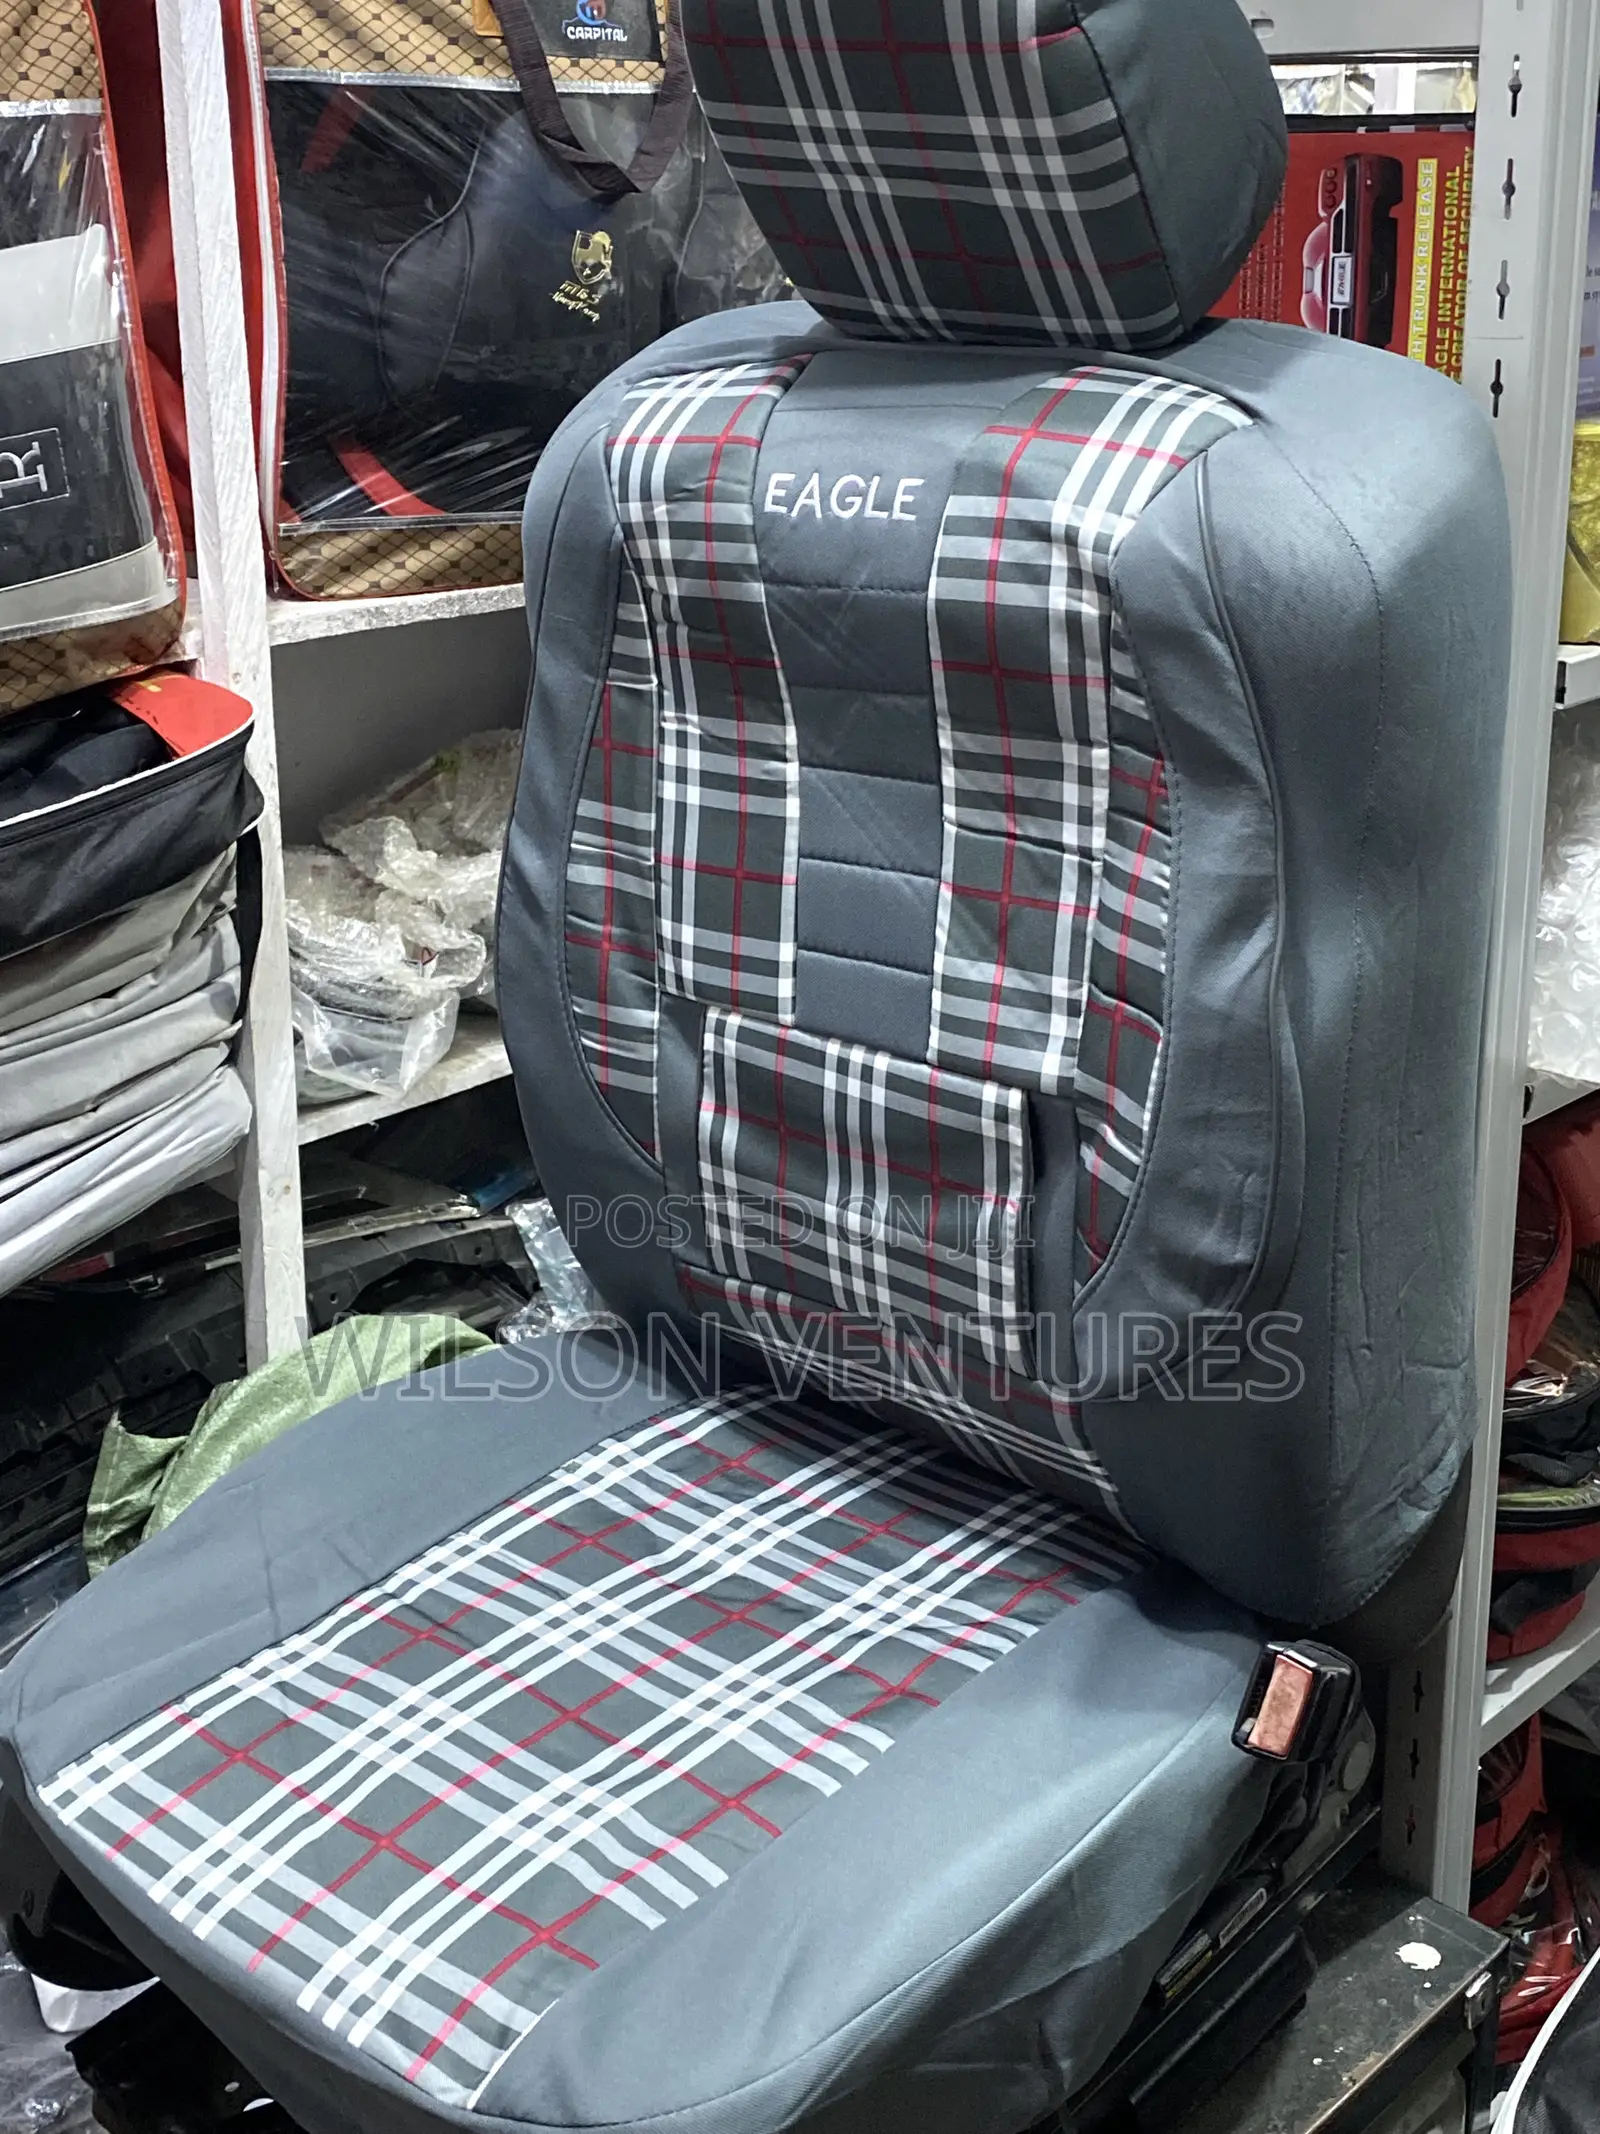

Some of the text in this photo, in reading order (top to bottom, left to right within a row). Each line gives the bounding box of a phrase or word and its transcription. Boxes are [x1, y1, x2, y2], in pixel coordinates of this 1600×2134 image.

[566, 26, 628, 42] CARPITAL
[1416, 162, 1434, 258] RELEASE
[1411, 263, 1428, 333] TRUNK
[1435, 165, 1461, 375] AGLE INTERNATIONAL
[763, 472, 925, 522] EAGLE
